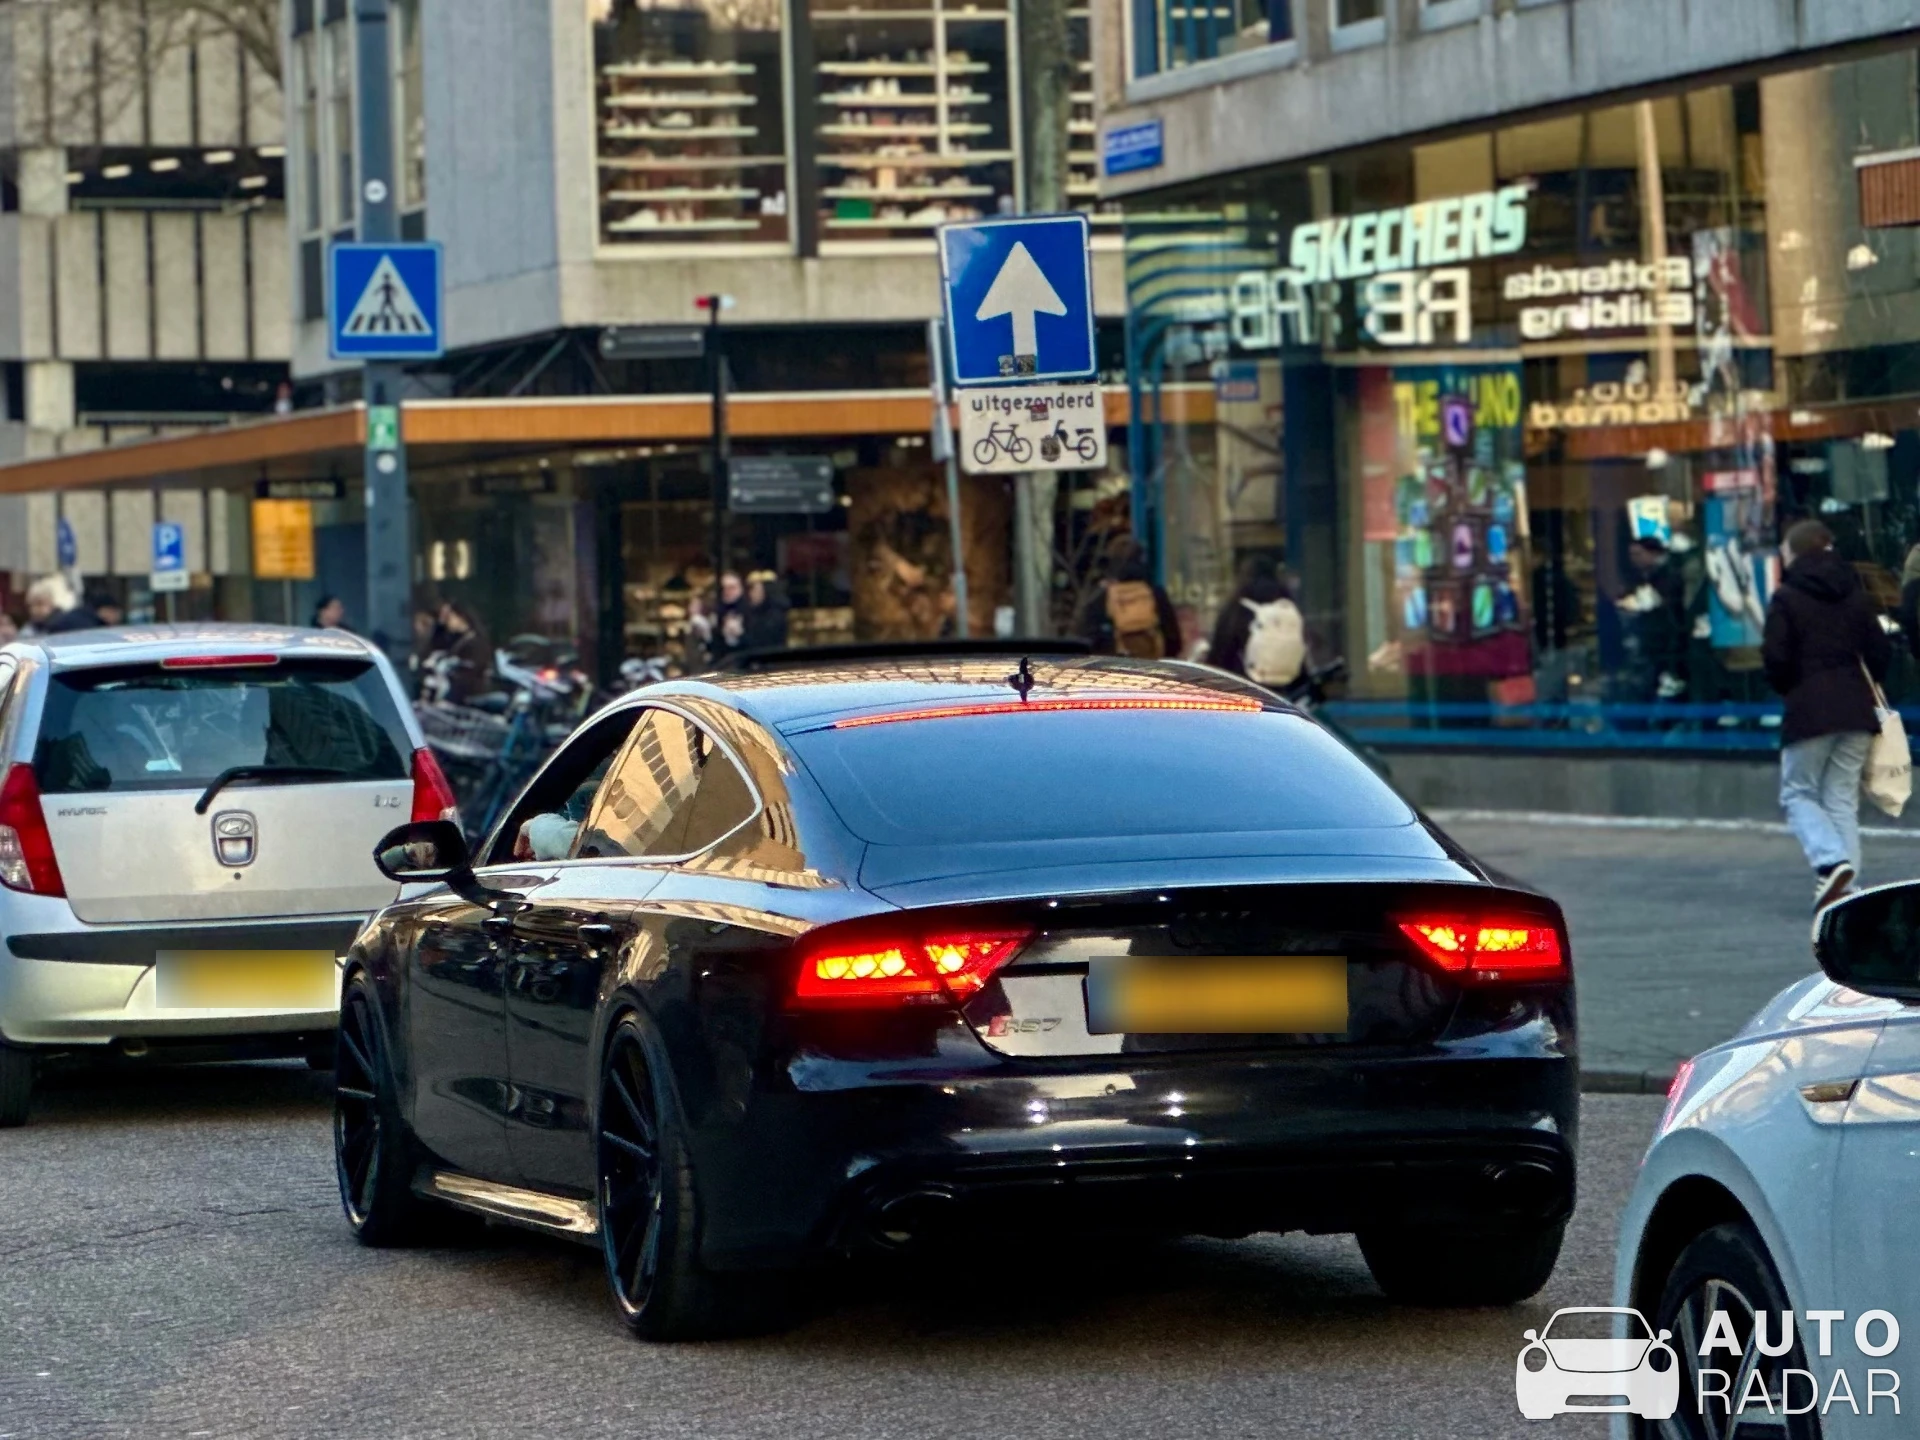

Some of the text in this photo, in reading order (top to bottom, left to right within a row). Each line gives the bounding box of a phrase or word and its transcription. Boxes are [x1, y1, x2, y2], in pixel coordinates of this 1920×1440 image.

[1290, 184, 1529, 286] SKECHERS
[972, 392, 1095, 416] uitgezonderd
[160, 525, 178, 554] P
[1000, 1017, 1062, 1033] RS7
